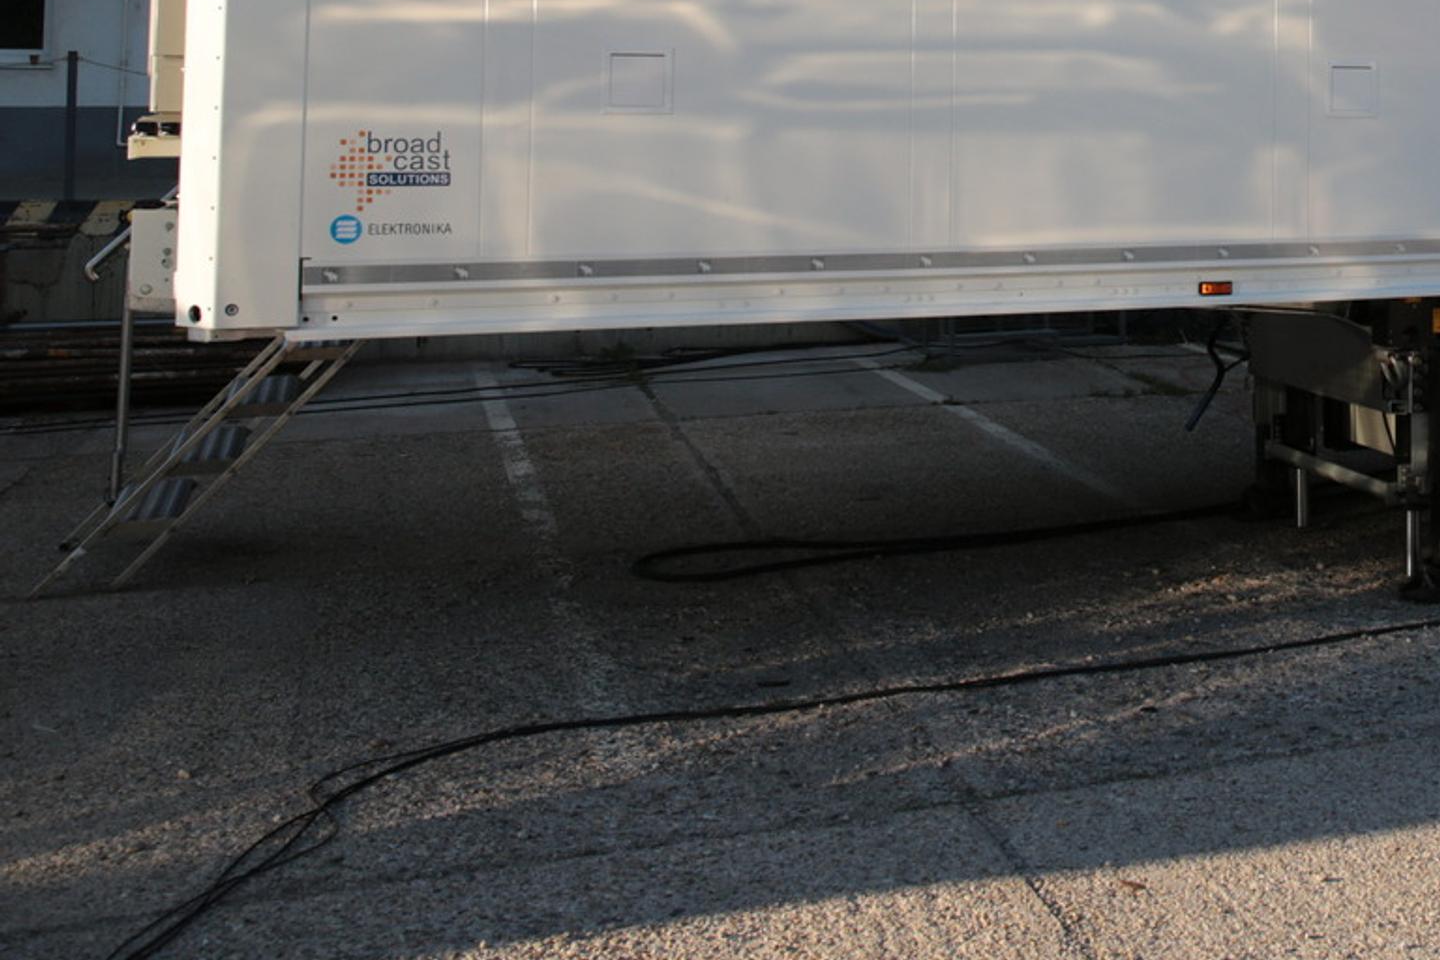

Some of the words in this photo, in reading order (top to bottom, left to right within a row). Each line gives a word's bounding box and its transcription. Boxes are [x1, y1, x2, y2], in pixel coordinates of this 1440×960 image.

[367, 130, 441, 153] broad
[393, 150, 451, 171] cast
[369, 173, 449, 185] SOLUTIONS
[368, 223, 452, 236] ELEKTRONIKA
